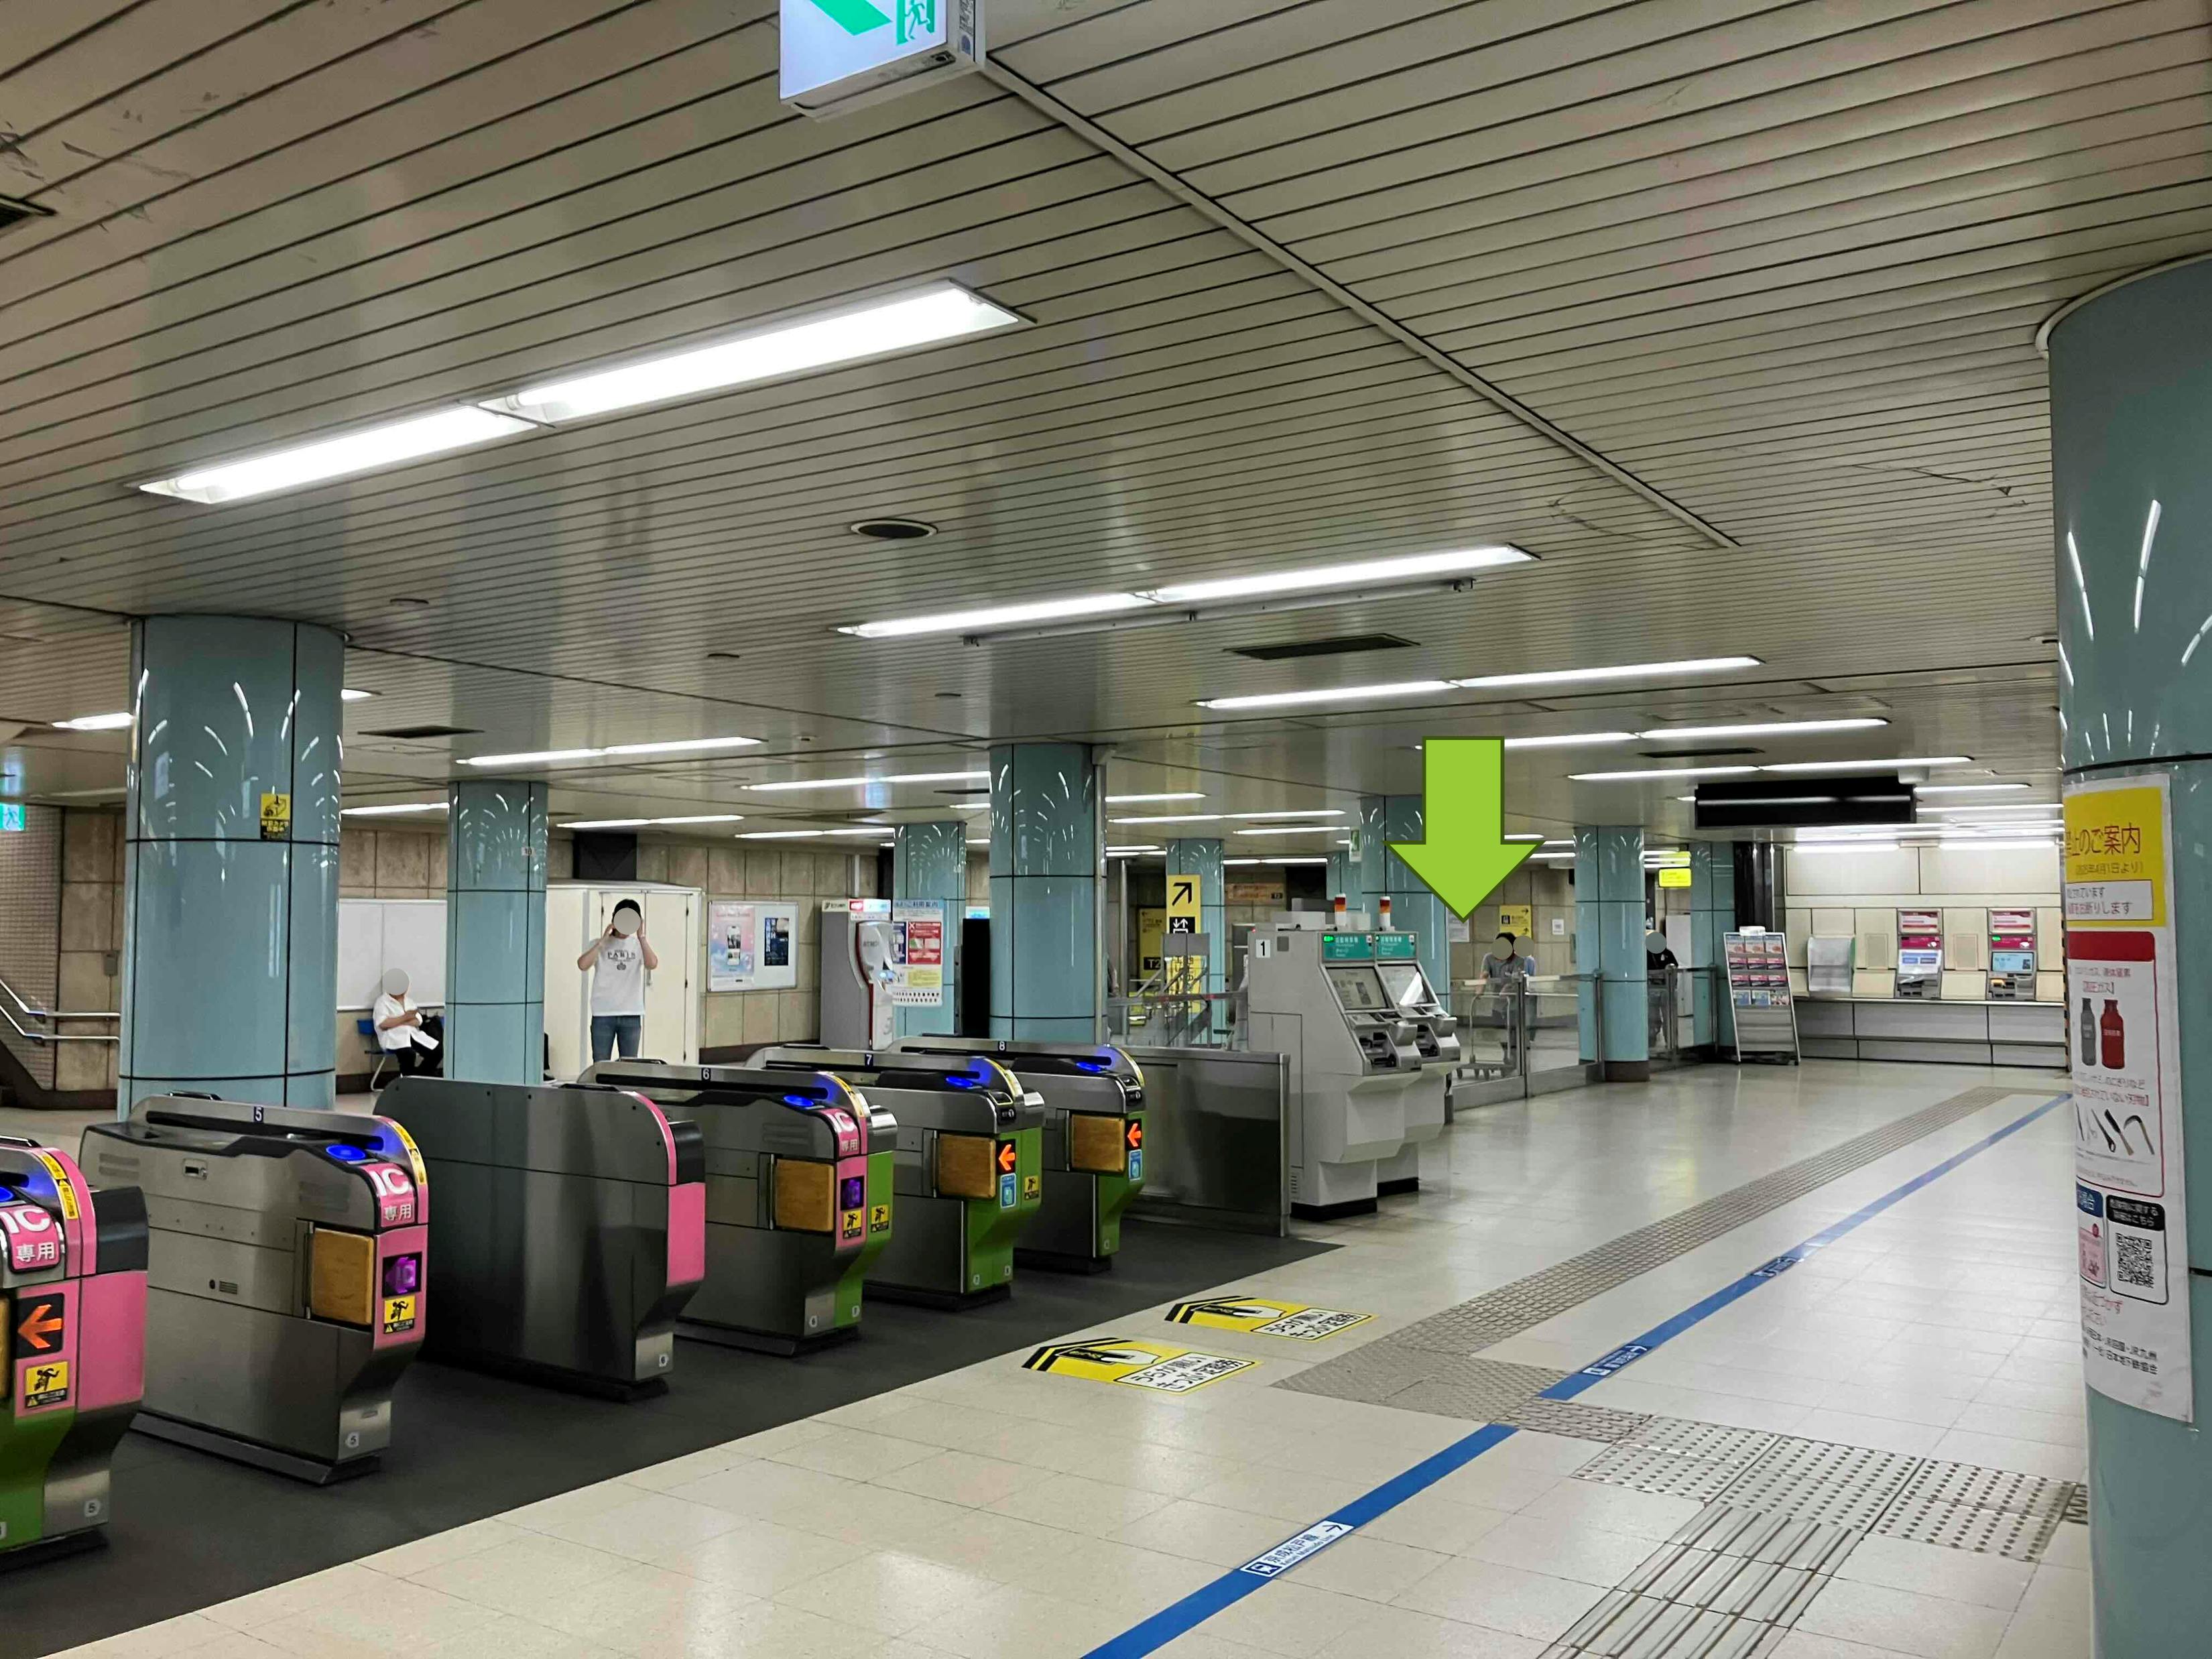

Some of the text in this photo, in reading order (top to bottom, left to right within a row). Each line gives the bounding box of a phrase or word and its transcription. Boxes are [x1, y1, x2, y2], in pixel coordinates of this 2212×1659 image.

[1260, 942, 1266, 956] 1
[1148, 959, 1160, 968] T2
[999, 1041, 1005, 1050] 8
[866, 1055, 871, 1064] 7
[703, 1069, 709, 1079] 6
[255, 1107, 261, 1121] 5
[830, 1112, 856, 1133] IC
[369, 1168, 409, 1196] IC
[384, 1204, 412, 1221] 専用
[0, 1209, 51, 1234] IC
[16, 1242, 55, 1263] 専用
